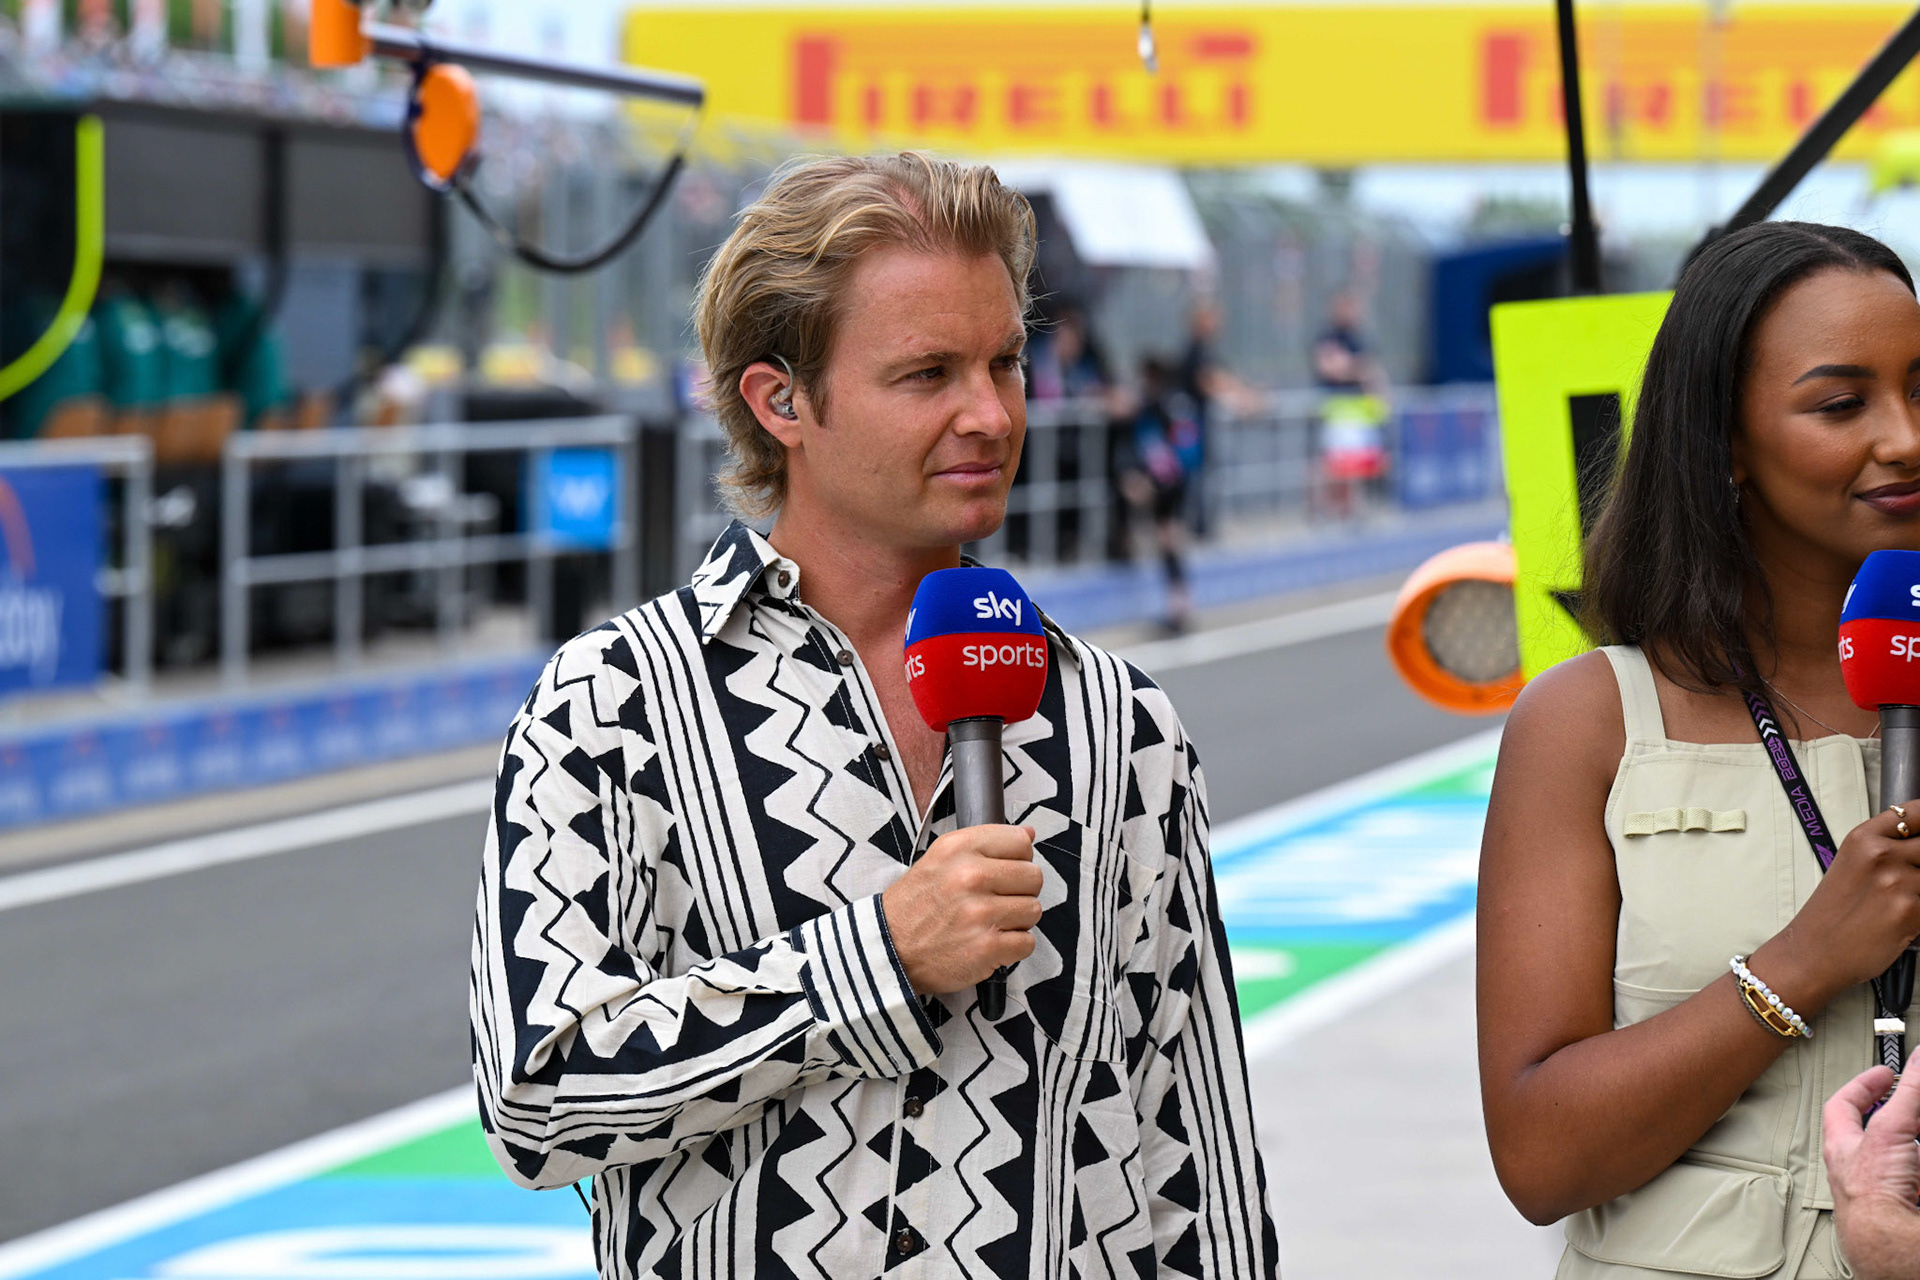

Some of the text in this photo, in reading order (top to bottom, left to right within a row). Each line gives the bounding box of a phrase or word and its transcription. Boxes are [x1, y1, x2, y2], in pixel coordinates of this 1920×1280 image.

[793, 32, 1257, 130] PIRELLI
[973, 591, 1022, 626] sky
[962, 642, 1045, 671] sports
[1767, 736, 1798, 781] 2024
[1790, 785, 1824, 836] MEDIA
